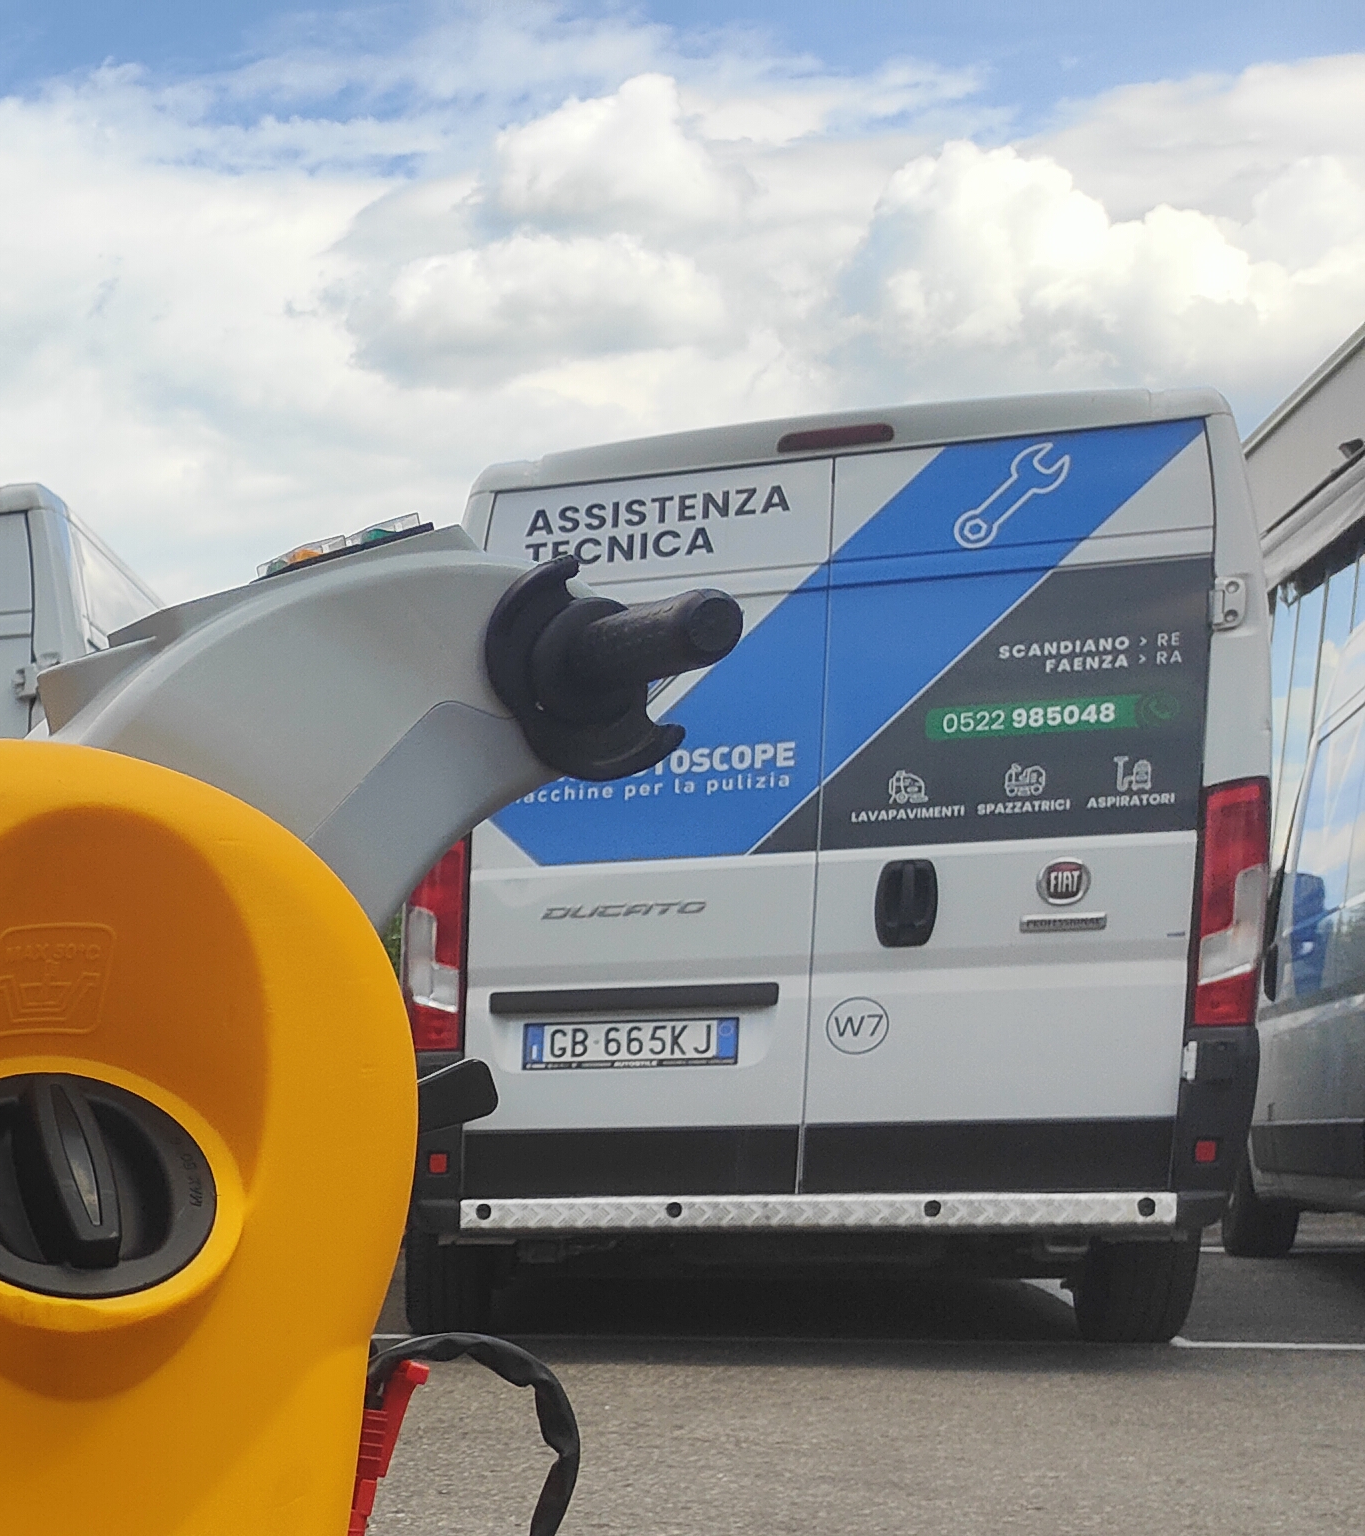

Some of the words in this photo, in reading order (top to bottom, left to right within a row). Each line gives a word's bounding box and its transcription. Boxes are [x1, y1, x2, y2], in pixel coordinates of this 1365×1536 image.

[525, 485, 791, 537] ASSISTENZA
[525, 527, 714, 565] TECNICA
[998, 636, 1130, 660] SCANDIANO
[1156, 632, 1182, 647] RE
[1045, 653, 1129, 673] FAENZA
[1156, 650, 1183, 665] RA
[942, 710, 1006, 733] 0522
[1011, 702, 1117, 729] 985048
[624, 782, 663, 801] per
[674, 778, 695, 795] la
[706, 772, 791, 795] pulizia
[976, 799, 1071, 816] SPAZZATRICI
[1086, 793, 1176, 809] ASPIRATORI
[851, 804, 965, 823] LAVAPAVIMENTI
[1050, 870, 1081, 893] FIAT
[541, 901, 707, 921] DUCATO
[834, 1013, 884, 1037] W7
